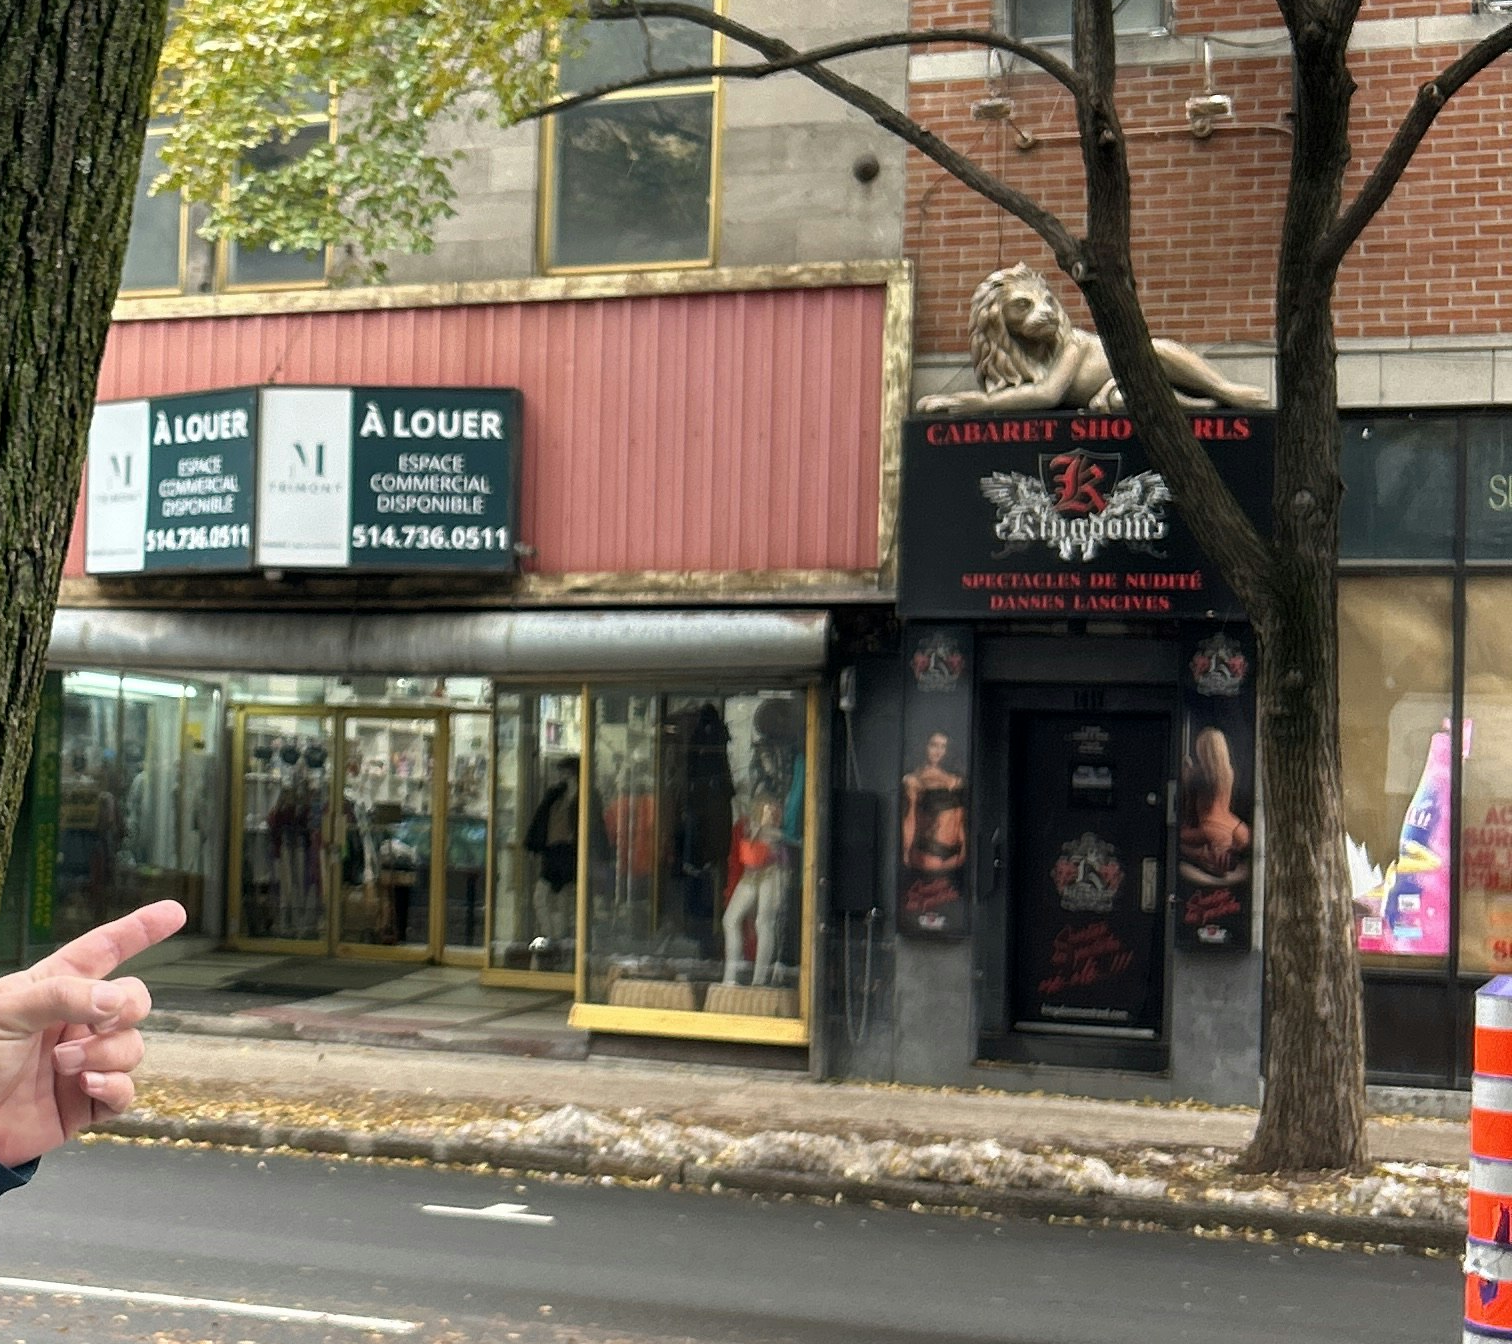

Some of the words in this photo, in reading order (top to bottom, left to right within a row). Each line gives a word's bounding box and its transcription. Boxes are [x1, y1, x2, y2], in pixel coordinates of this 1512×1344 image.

[153, 410, 172, 446] À
[174, 408, 249, 444] LOUER
[360, 401, 386, 438] À
[393, 408, 504, 440] LOUER
[925, 419, 1059, 446] CABARET
[1070, 417, 1252, 441] SHORLS
[177, 455, 224, 477] ESPACE
[398, 453, 465, 473] ESPACE
[158, 474, 241, 498] COMMERCIAL
[370, 473, 491, 494] COMMERCIAL
[161, 494, 236, 517] DISPONIBLE
[377, 495, 485, 515] DISPONIBLE
[144, 523, 251, 552] 514.736.0511
[352, 525, 510, 551] 514.736.0511
[961, 573, 1081, 589] SPECTACLES
[1090, 573, 1117, 589] DE
[1125, 570, 1203, 590] NUDITÉ
[990, 595, 1065, 611] DANSES
[1074, 595, 1170, 611] LASCIVES
